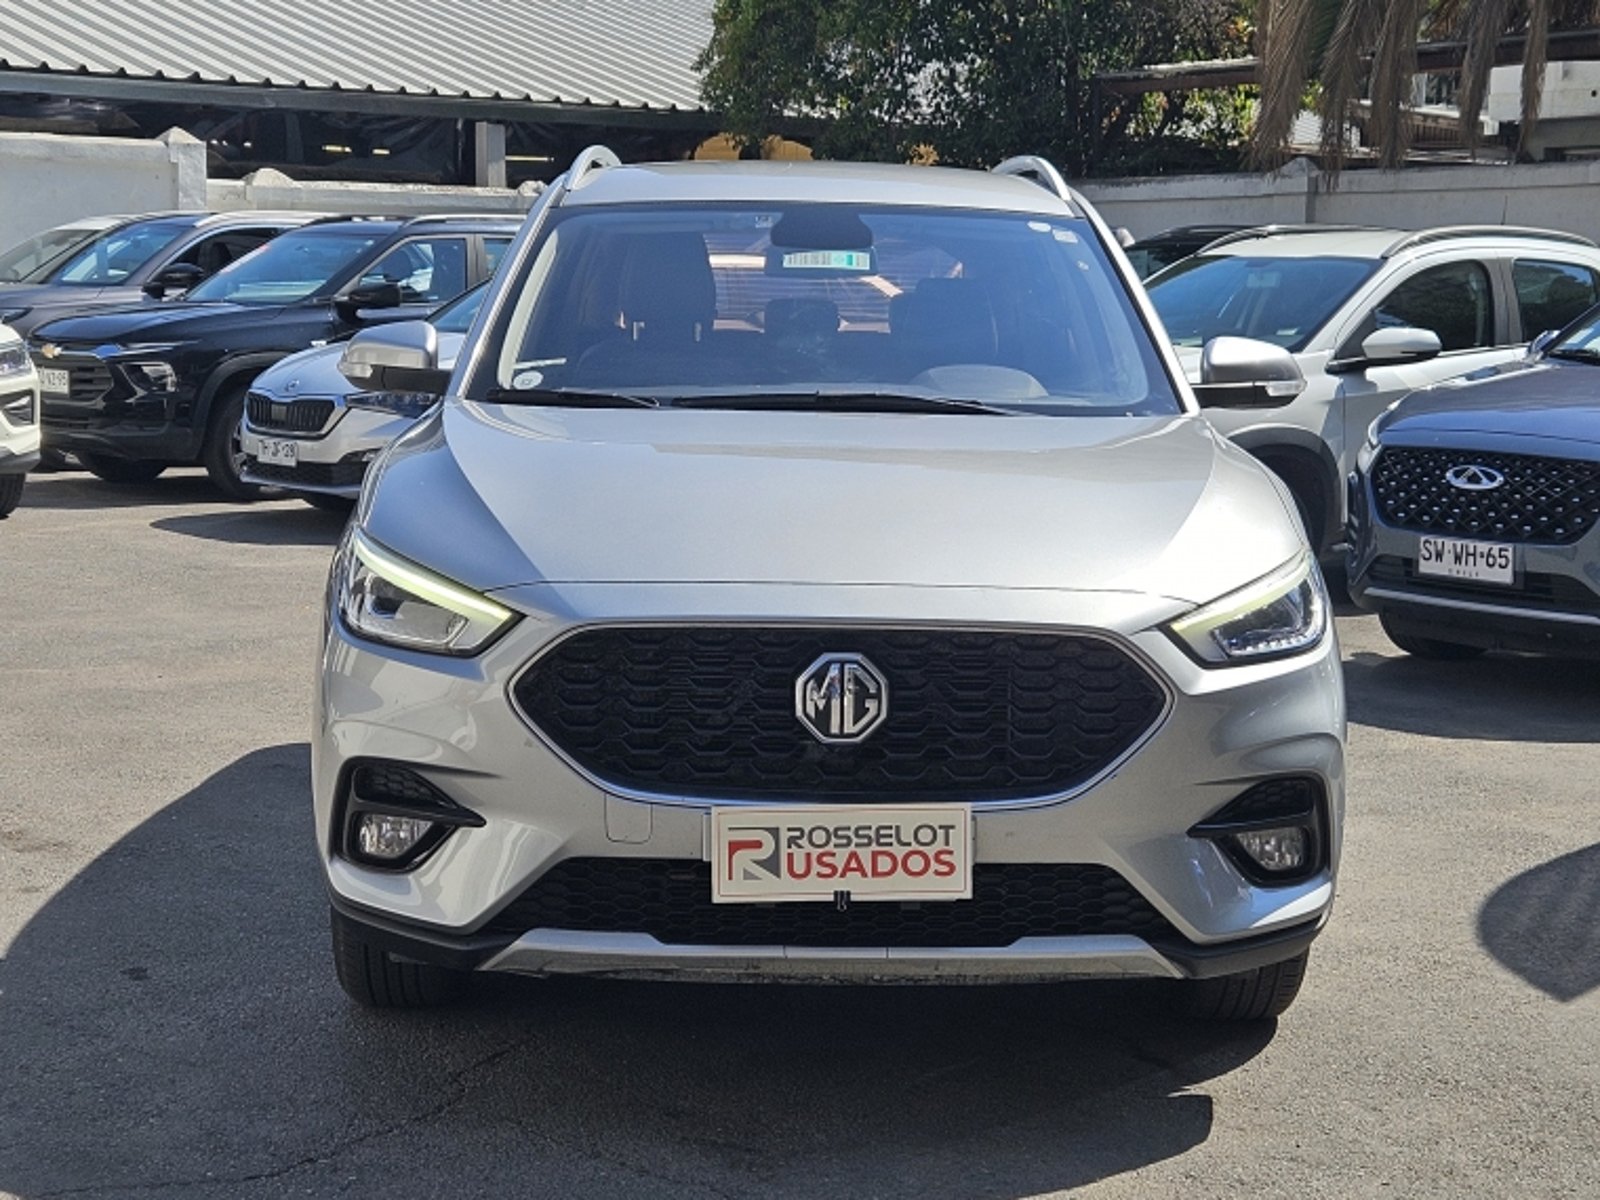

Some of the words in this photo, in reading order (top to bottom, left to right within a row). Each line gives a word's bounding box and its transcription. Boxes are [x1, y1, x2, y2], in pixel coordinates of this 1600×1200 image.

[806, 663, 878, 733] MG
[787, 824, 955, 848] ROSSELOT
[787, 850, 956, 879] USADOS
